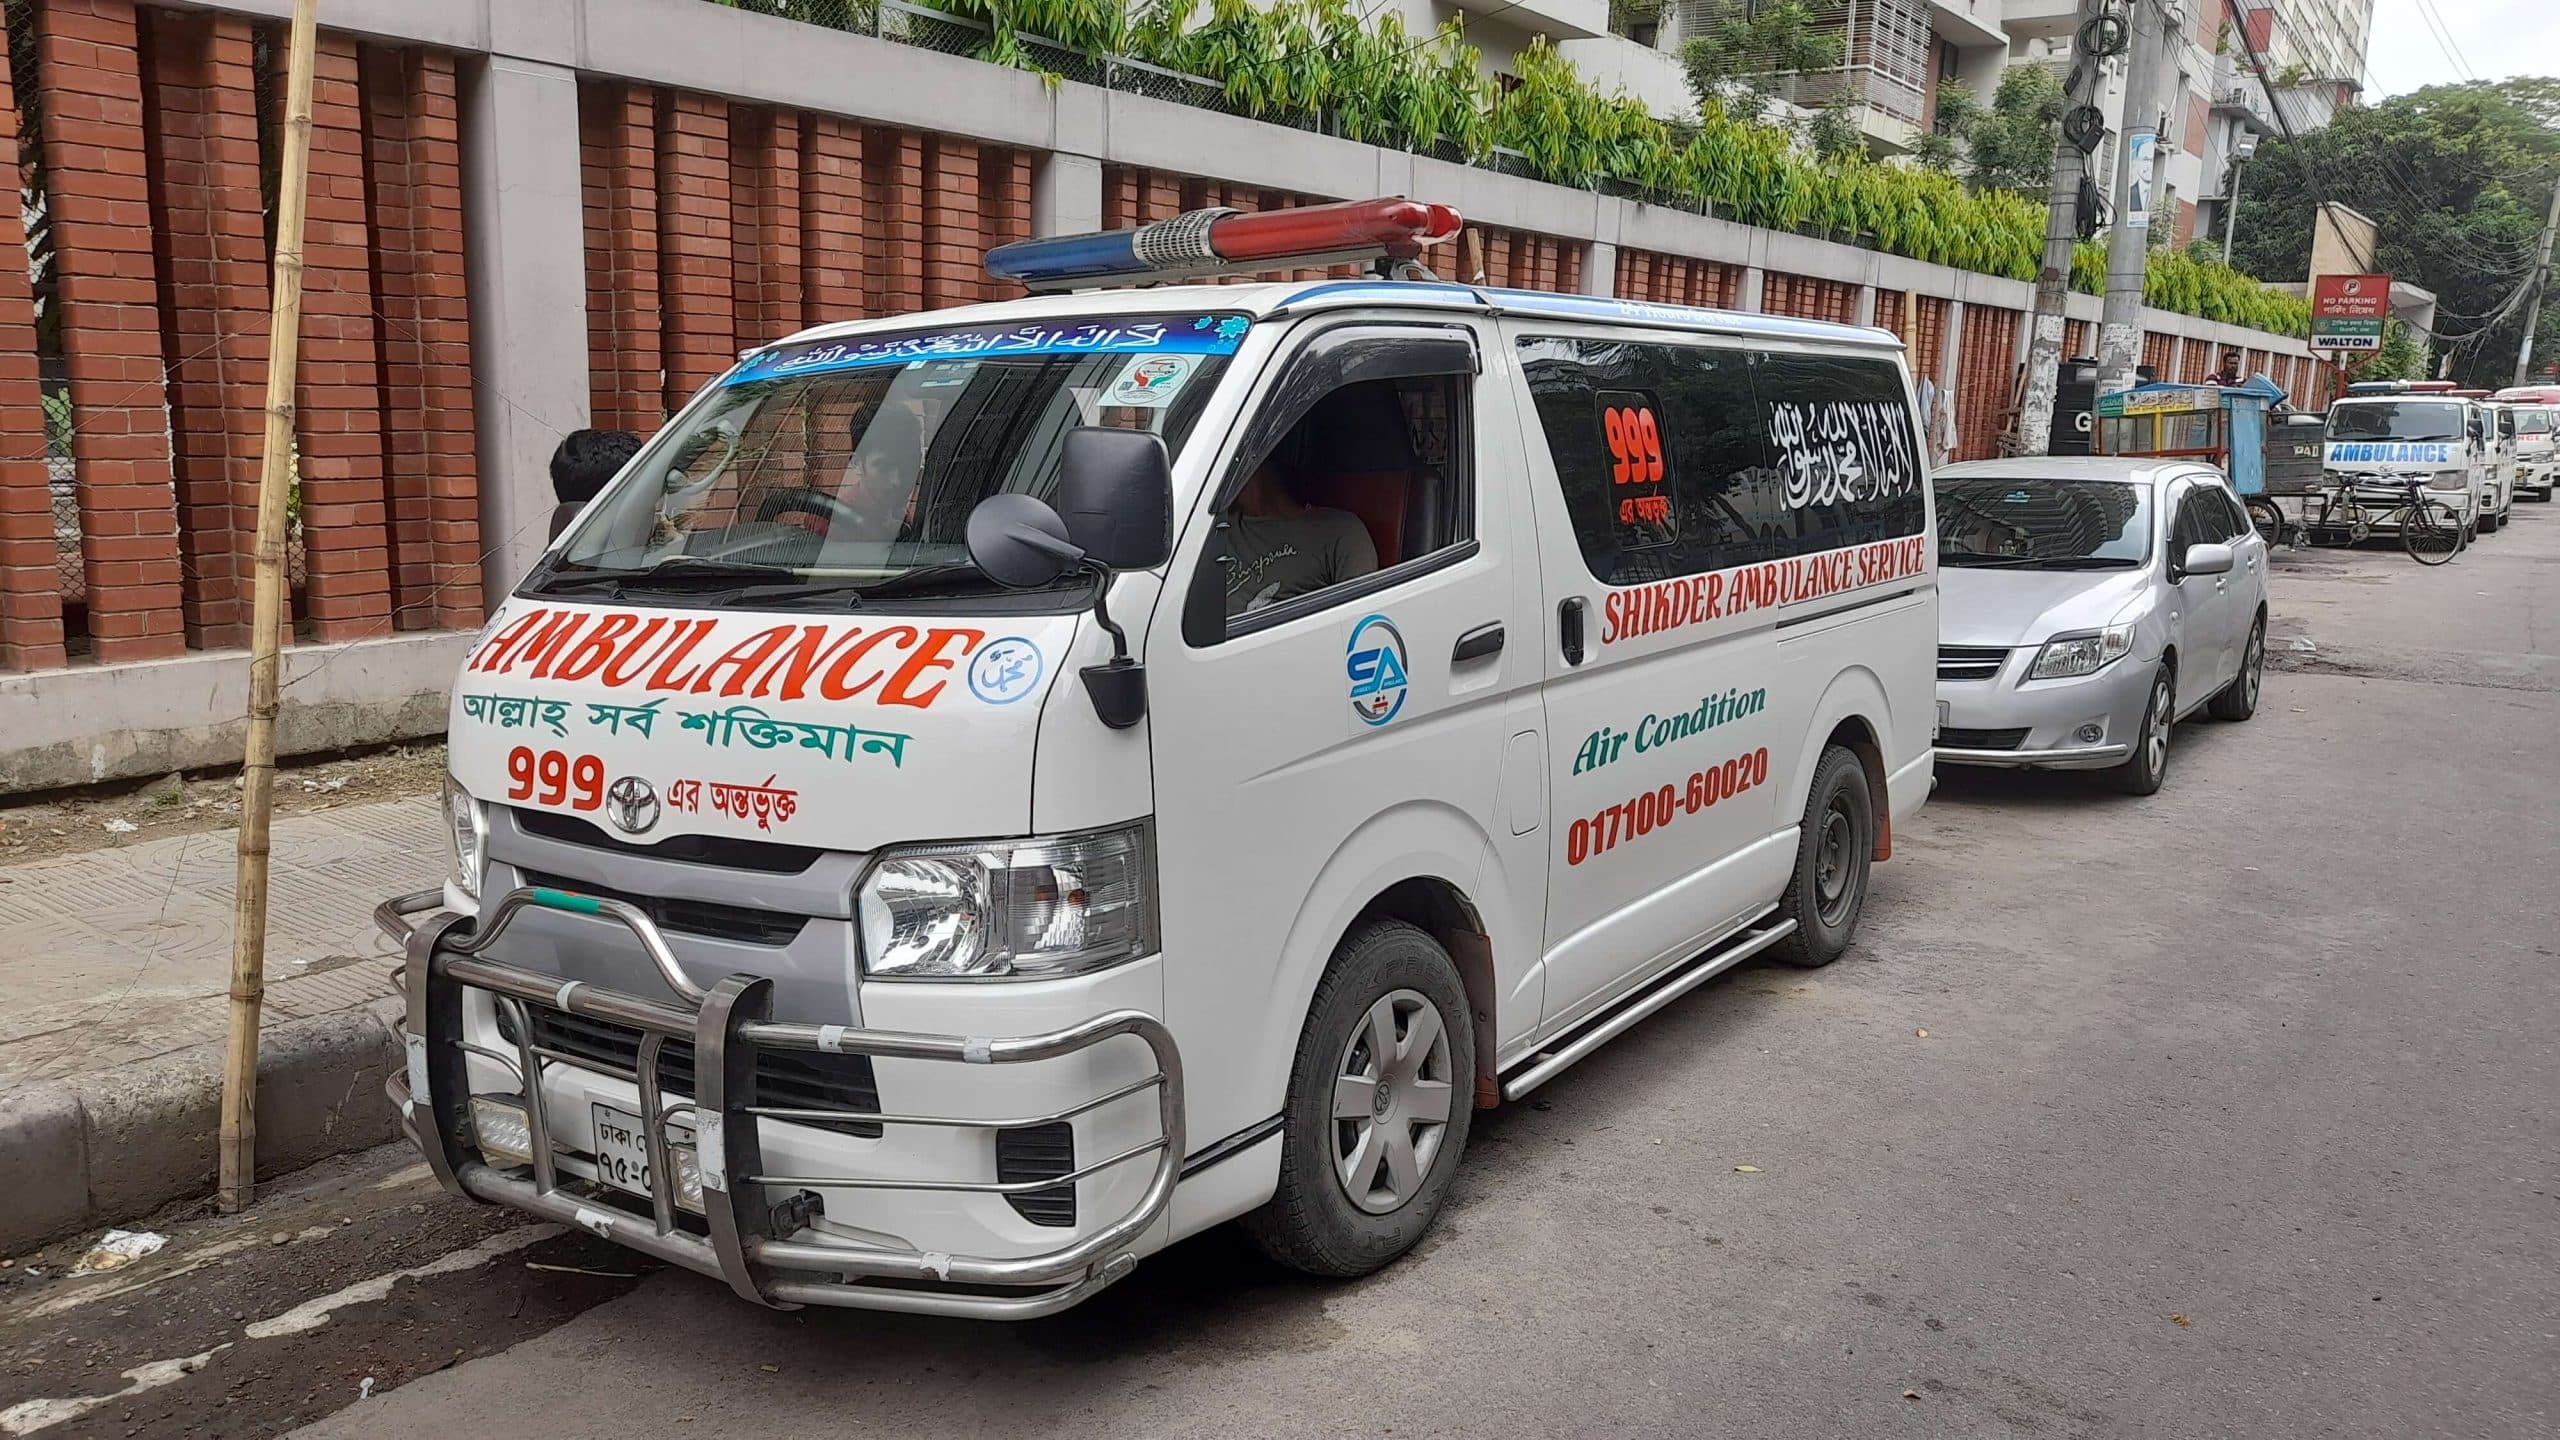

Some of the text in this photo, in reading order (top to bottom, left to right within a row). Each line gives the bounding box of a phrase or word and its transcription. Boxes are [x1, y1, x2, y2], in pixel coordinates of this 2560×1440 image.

[2323, 297, 2377, 305] NO PARKING
[2318, 338, 2373, 346] WALTON
[1604, 406, 1664, 484] 999
[2330, 443, 2447, 463] AMBULANCE
[1602, 536, 1925, 645] SHIKDER AMBULANCE SERVICE
[467, 608, 985, 709] AMBULANCE
[587, 697, 669, 740] সর্ব
[676, 705, 916, 768] শক্তিমান
[1573, 688, 1766, 776] Air Condition
[507, 745, 605, 811] 999
[667, 774, 799, 834] এর অন্তর্ভুক্ত
[1567, 747, 1768, 866] 017100-60020
[600, 1123, 632, 1149] ঢাকা
